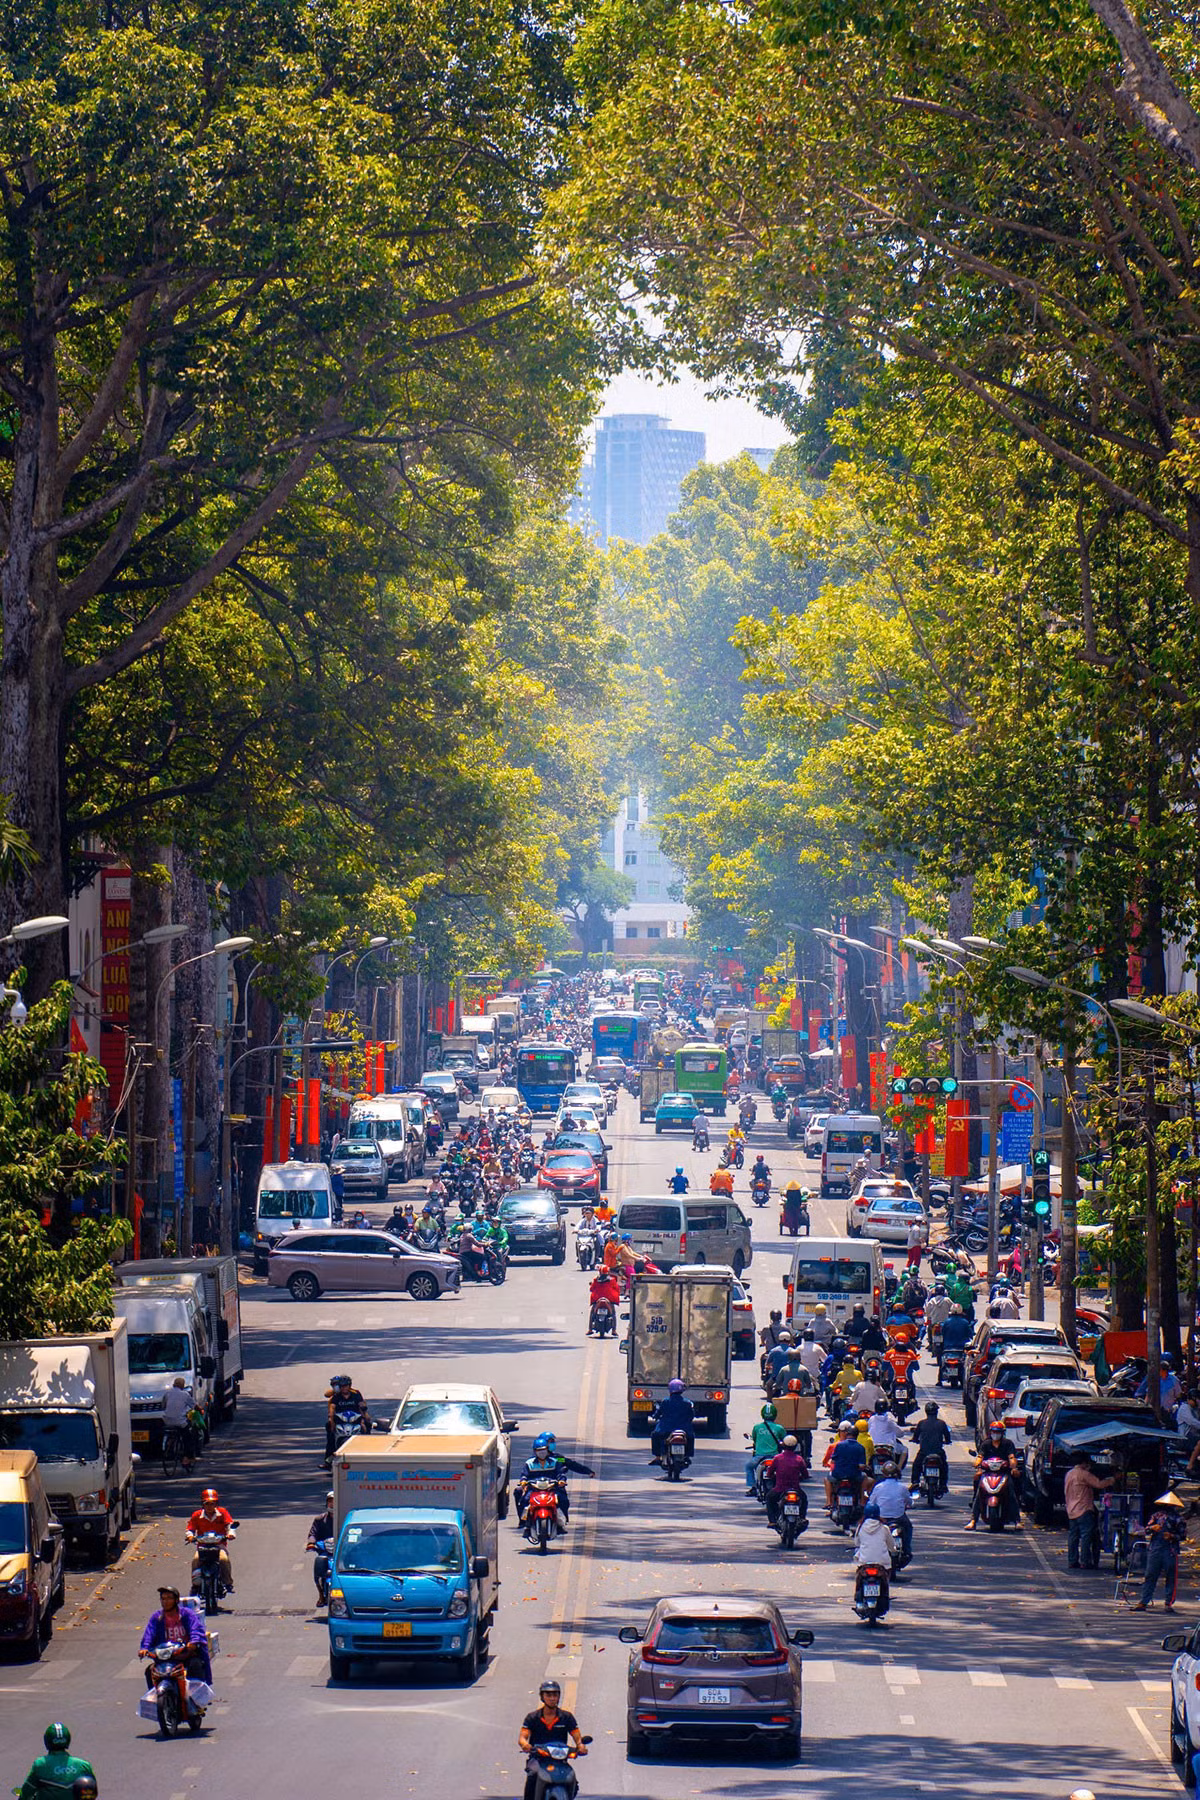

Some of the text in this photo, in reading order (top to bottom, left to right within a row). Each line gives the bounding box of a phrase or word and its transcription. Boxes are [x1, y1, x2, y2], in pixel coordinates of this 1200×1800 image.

[103, 961, 128, 984] LUÂ
[1035, 1150, 1048, 1164] 24
[702, 1695, 728, 1704] 971.53
[54, 1765, 77, 1775] Grab
